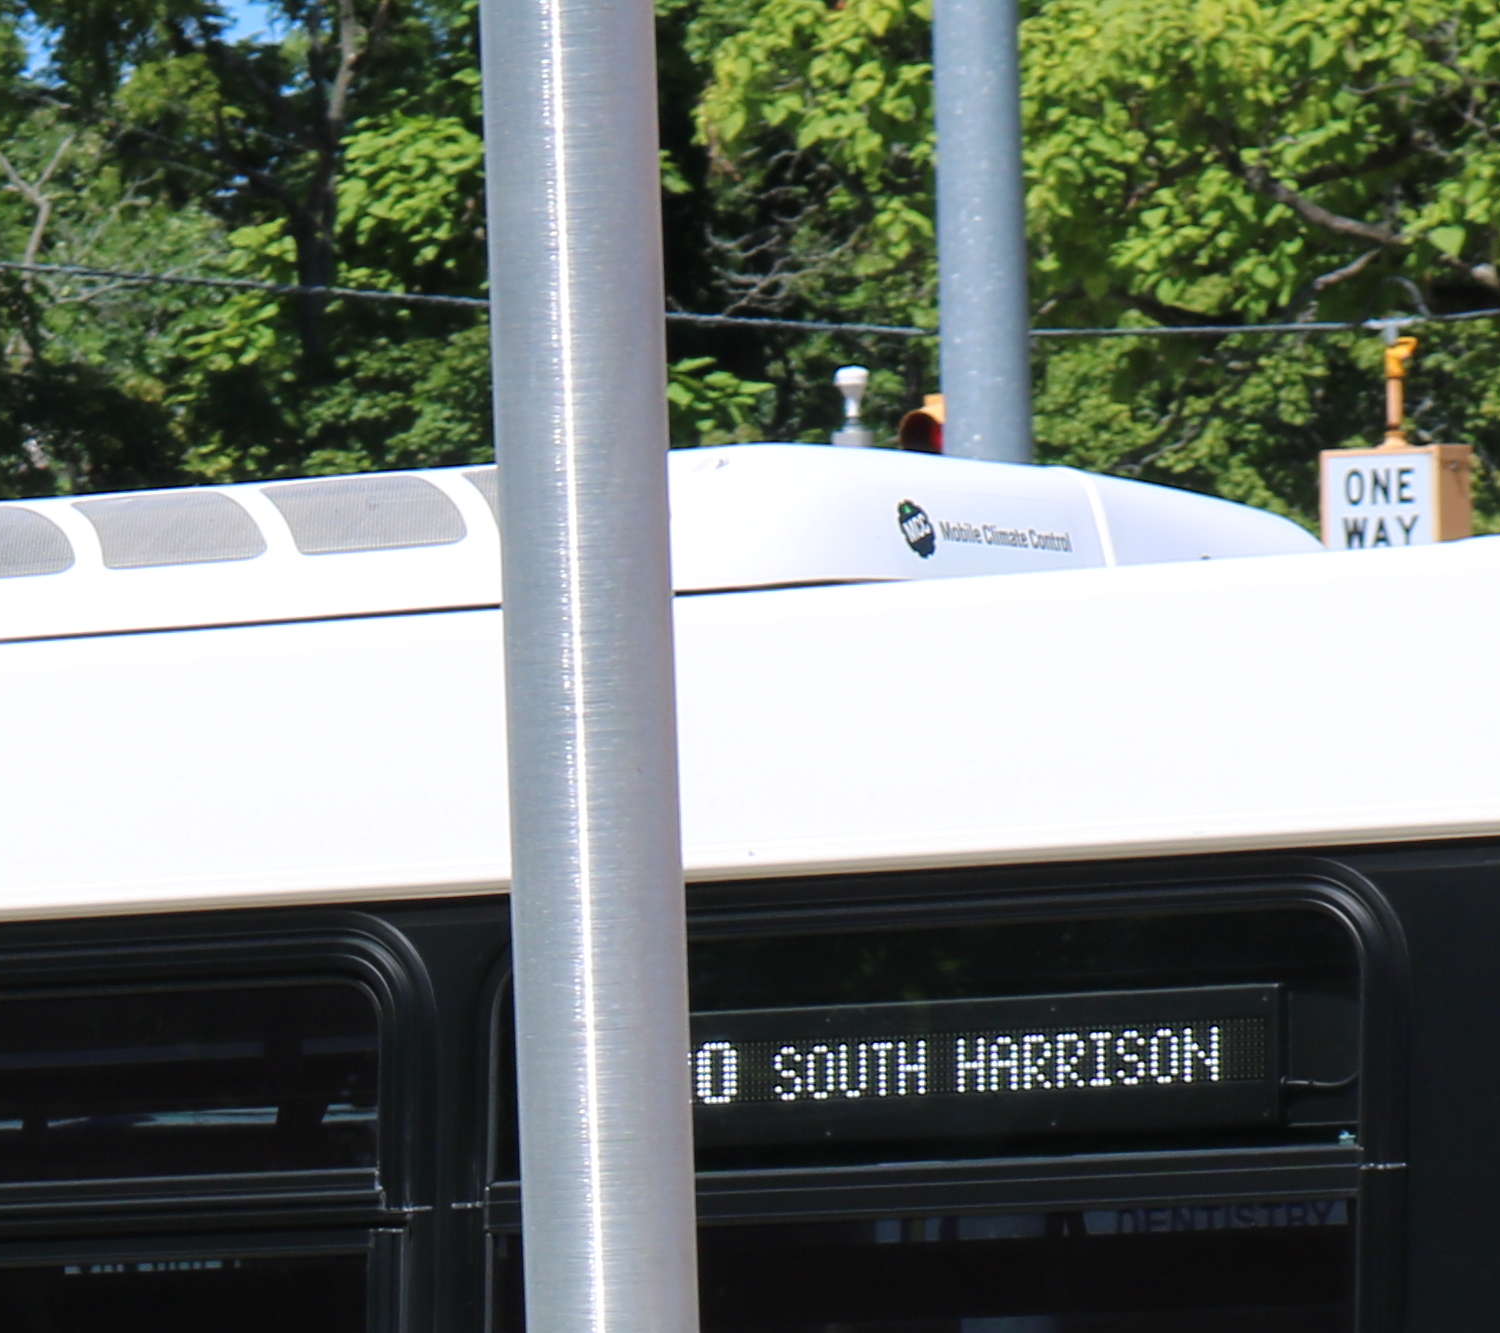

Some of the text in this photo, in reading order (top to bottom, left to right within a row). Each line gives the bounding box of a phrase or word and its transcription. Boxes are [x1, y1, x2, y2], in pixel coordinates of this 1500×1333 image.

[1343, 467, 1416, 506] ONE
[938, 520, 1073, 553] Mobile Climate Control
[1342, 514, 1420, 550] WAY
[772, 1038, 927, 1102] SOUTH
[955, 1025, 1222, 1095] HARRISON
